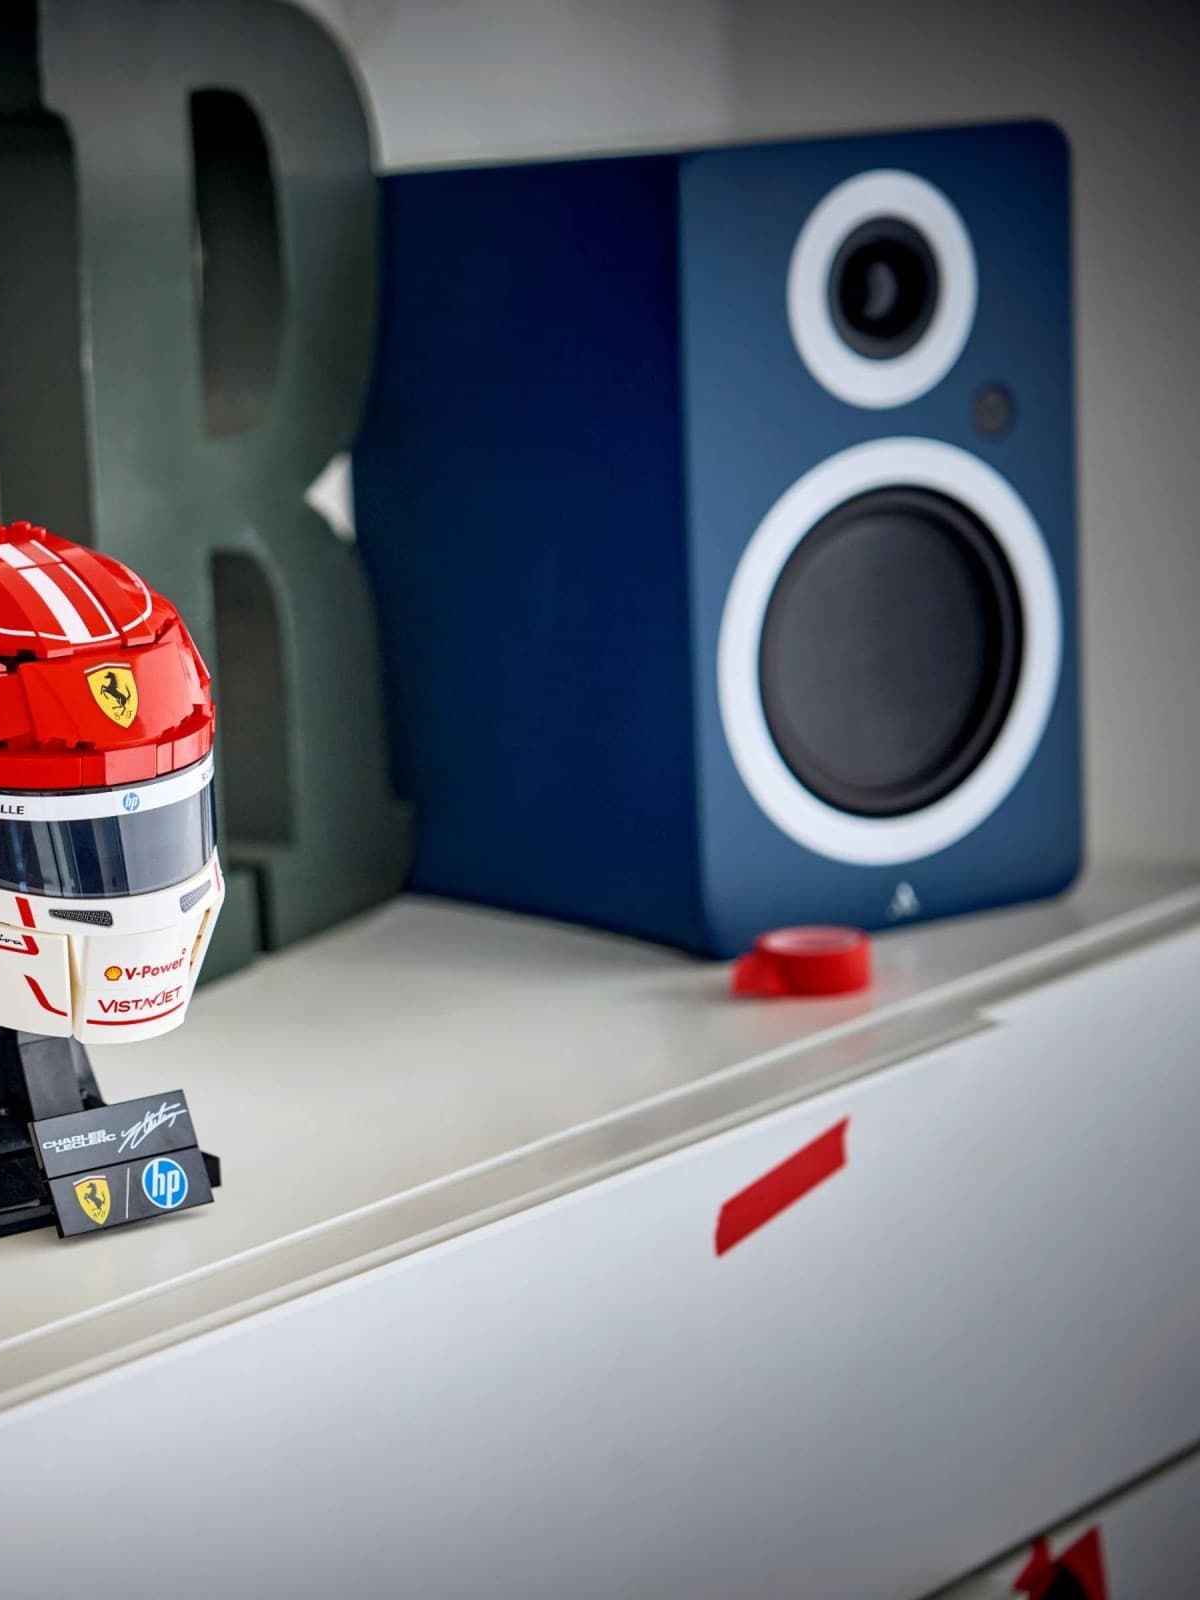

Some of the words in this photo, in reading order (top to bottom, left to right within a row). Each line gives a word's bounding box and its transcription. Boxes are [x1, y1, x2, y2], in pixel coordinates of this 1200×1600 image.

[125, 958, 184, 980] V-Power
[42, 1129, 107, 1149] CHARLES
[55, 1133, 117, 1153] LECLERC
[149, 1158, 181, 1208] hp
